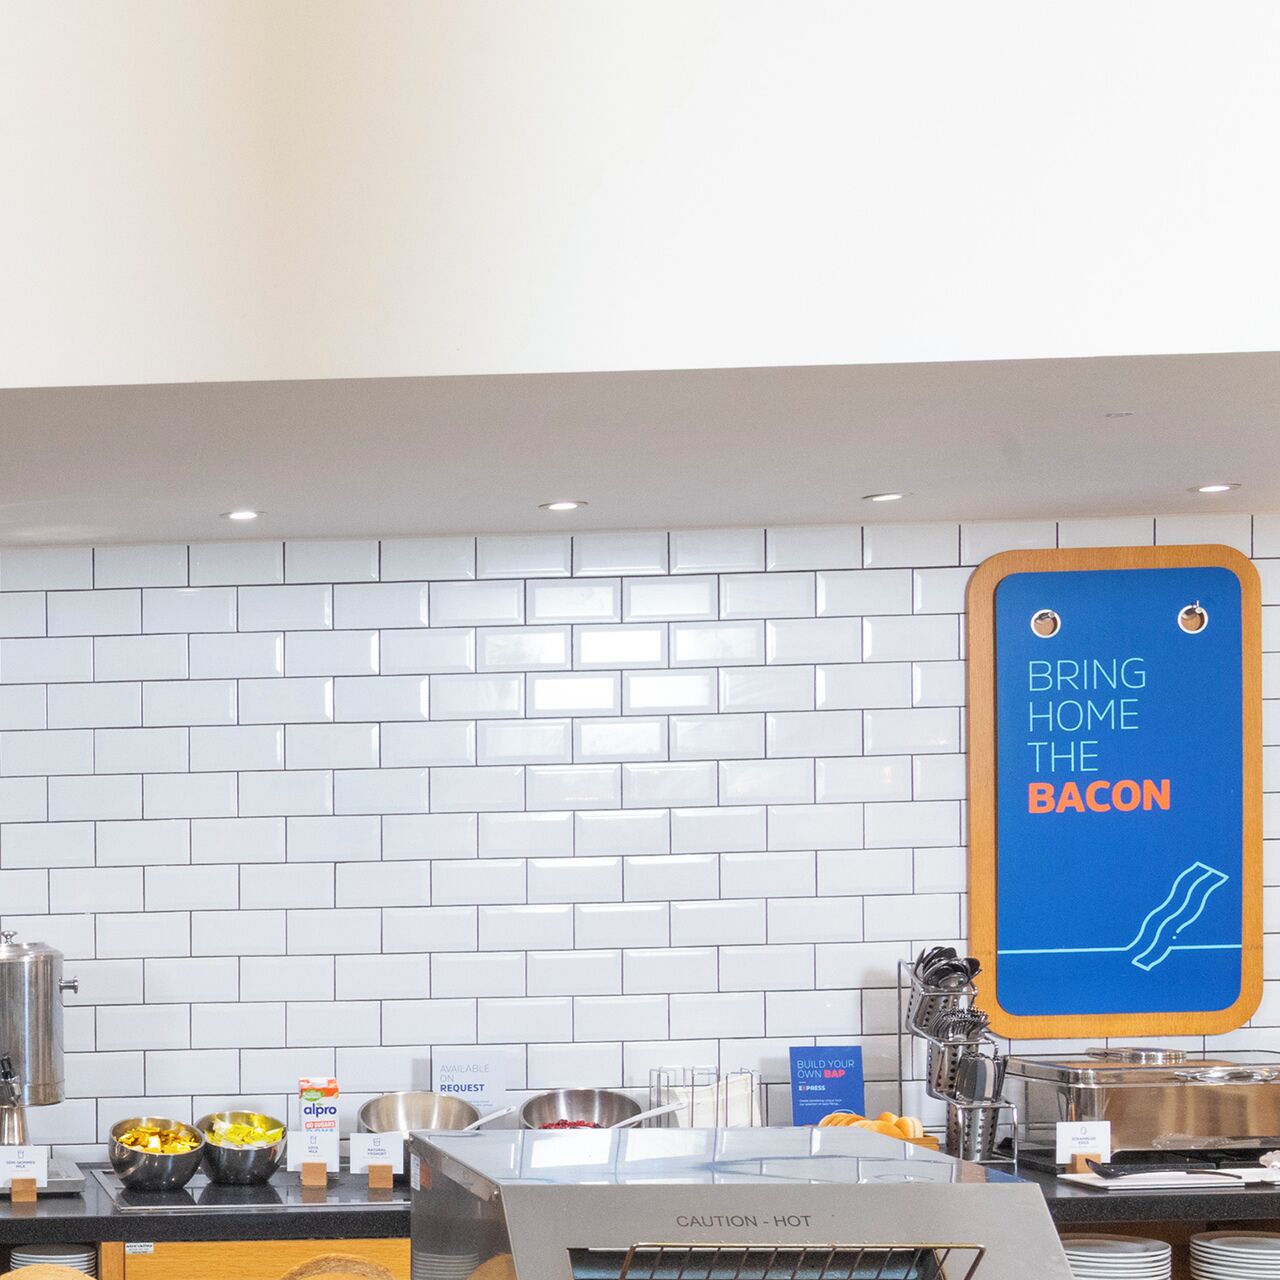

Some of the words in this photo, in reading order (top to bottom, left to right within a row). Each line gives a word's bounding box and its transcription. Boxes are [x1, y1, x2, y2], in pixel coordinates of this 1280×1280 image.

[1028, 657, 1147, 692] BRING
[1028, 698, 1139, 732] HOME
[1027, 740, 1099, 773] THE
[1028, 778, 1171, 814] BACON
[440, 1064, 489, 1073] AVAILABLE
[797, 1060, 825, 1069] BUILD
[827, 1059, 855, 1068] YOUR
[440, 1074, 454, 1082] ON
[797, 1070, 822, 1078] OWN
[823, 1069, 846, 1078] BAP
[440, 1083, 485, 1092] REQUEST
[304, 1103, 337, 1118] alpro
[676, 1214, 757, 1228] CAUTION
[774, 1214, 812, 1227] HOT
